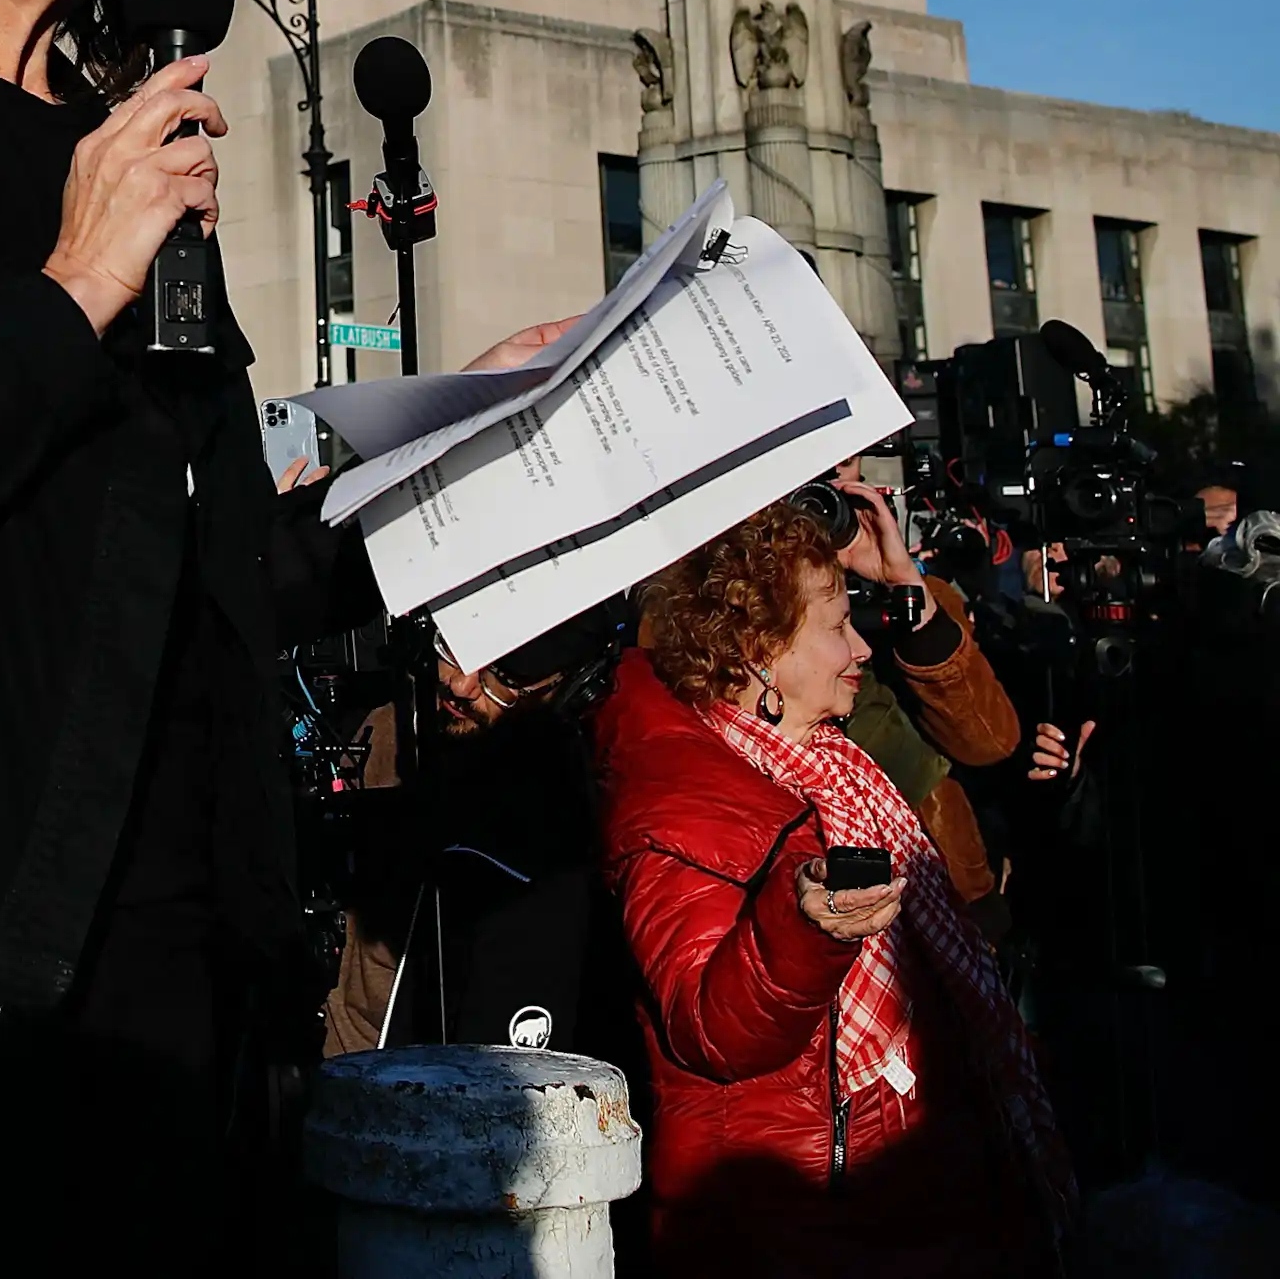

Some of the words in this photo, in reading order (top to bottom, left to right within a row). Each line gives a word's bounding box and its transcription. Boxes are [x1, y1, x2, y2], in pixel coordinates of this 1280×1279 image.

[332, 325, 391, 347] FLATBUSH
[761, 319, 776, 335] APR
[777, 345, 792, 363] 2024
[724, 329, 737, 345] when
[739, 356, 752, 374] came
[660, 348, 674, 365] about
[686, 398, 700, 416] what
[726, 363, 743, 386] golden
[663, 384, 677, 405] wants
[596, 395, 612, 422] worship
[600, 436, 612, 454] than
[532, 448, 548, 473] people
